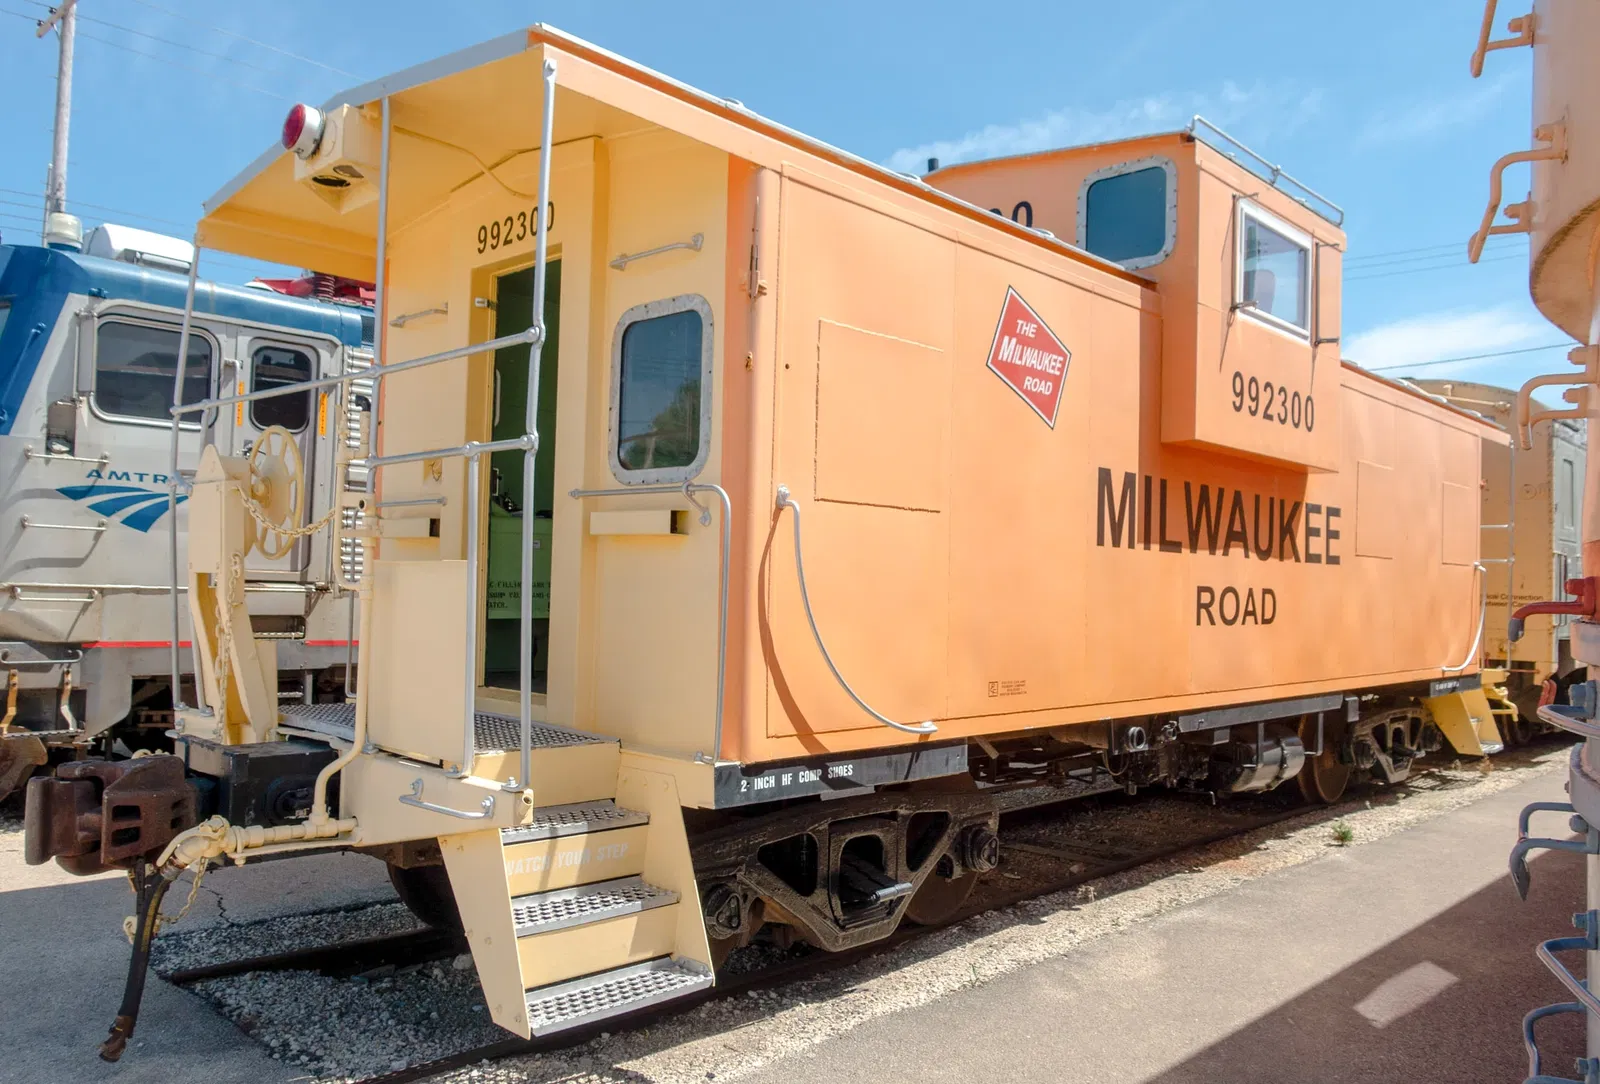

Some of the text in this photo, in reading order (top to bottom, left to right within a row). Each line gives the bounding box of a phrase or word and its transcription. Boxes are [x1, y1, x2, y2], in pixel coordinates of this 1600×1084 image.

[477, 201, 555, 254] 992300
[1016, 320, 1037, 338] THE
[998, 335, 1064, 376] MILWAUKEE
[1023, 376, 1053, 396] ROAD
[1232, 371, 1314, 432] 992300
[86, 469, 169, 484] AMTR
[1096, 466, 1341, 566] MILWAUKEE
[1196, 586, 1277, 626] ROAD
[754, 776, 775, 790] INCH
[782, 773, 793, 786] HF
[799, 769, 822, 783] COMP
[828, 764, 853, 779] SHOES
[557, 849, 591, 868] YOUR
[596, 843, 629, 861] STEP
